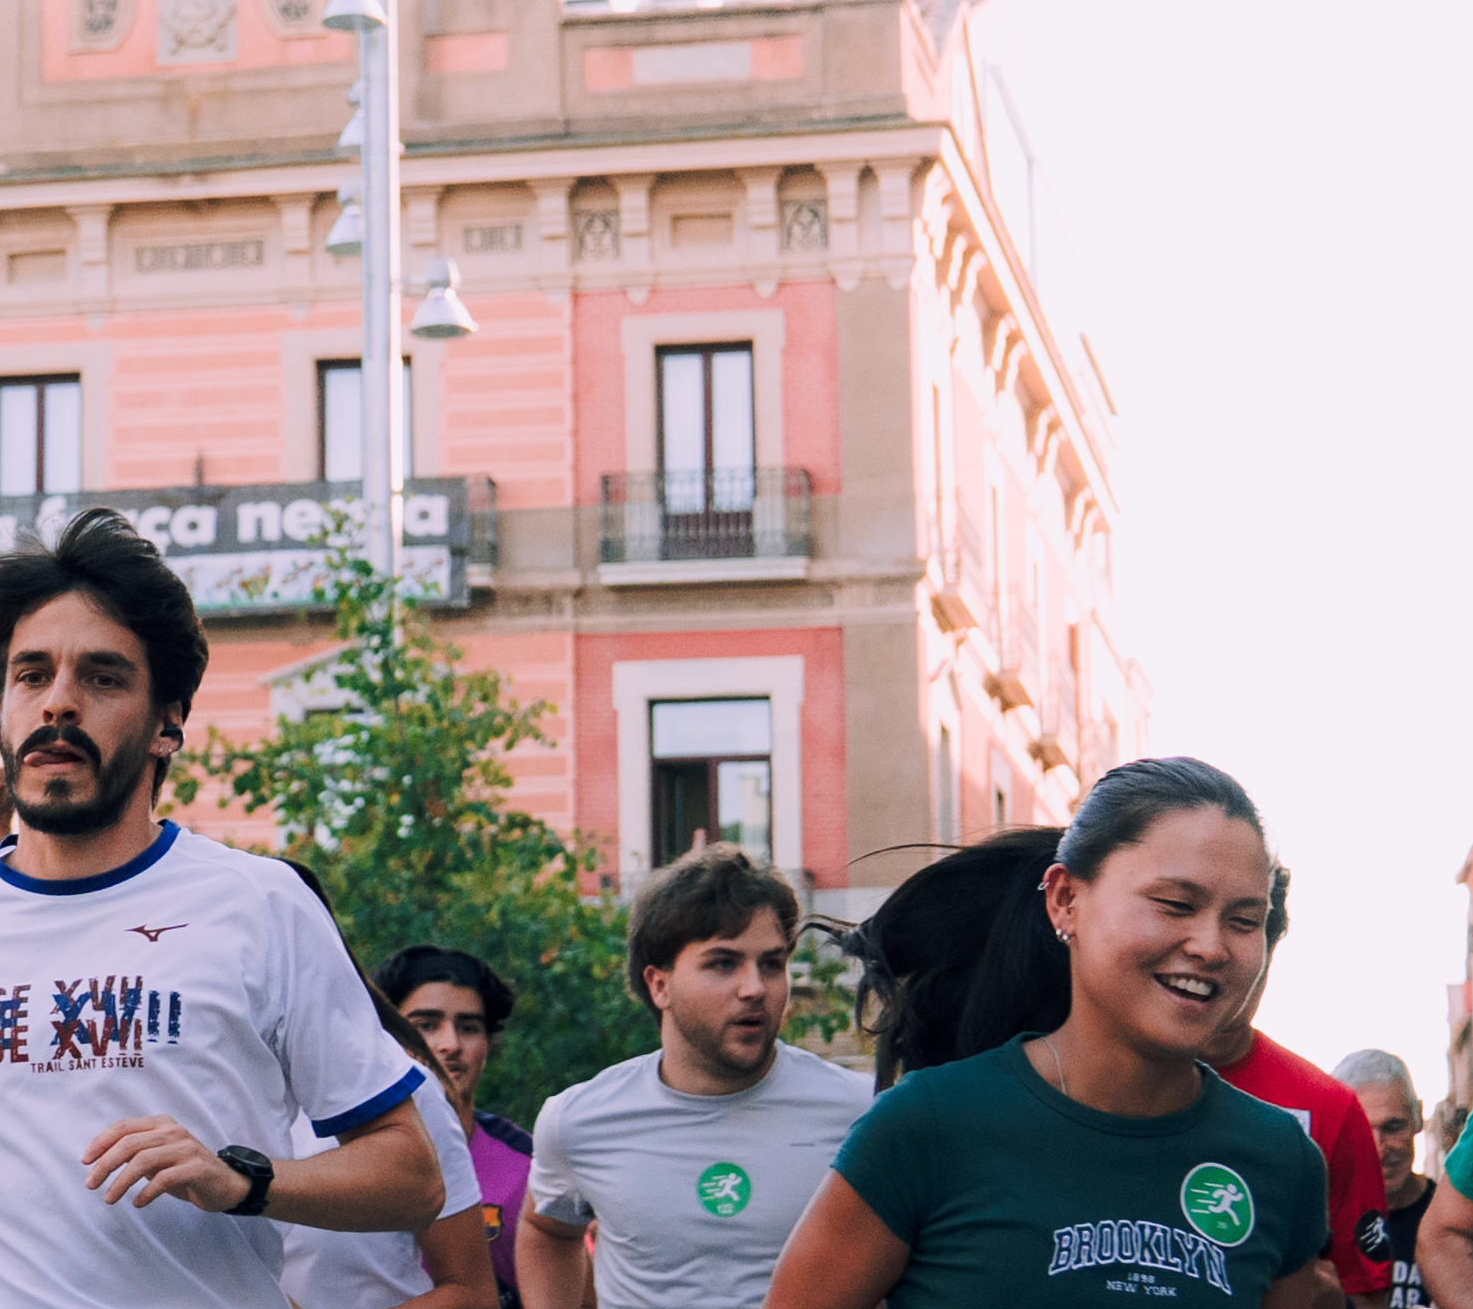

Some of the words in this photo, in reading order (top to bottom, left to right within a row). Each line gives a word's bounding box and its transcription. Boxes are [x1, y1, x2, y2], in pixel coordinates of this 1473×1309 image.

[37, 494, 217, 558] fça
[30, 1059, 65, 1073] TRAIL
[69, 1057, 97, 1071] SANT
[101, 1056, 145, 1070] ESTEVE
[1048, 1219, 1232, 1295] BROOKLYN
[1106, 1280, 1138, 1293] NEW
[1143, 1285, 1178, 1297] YORK
